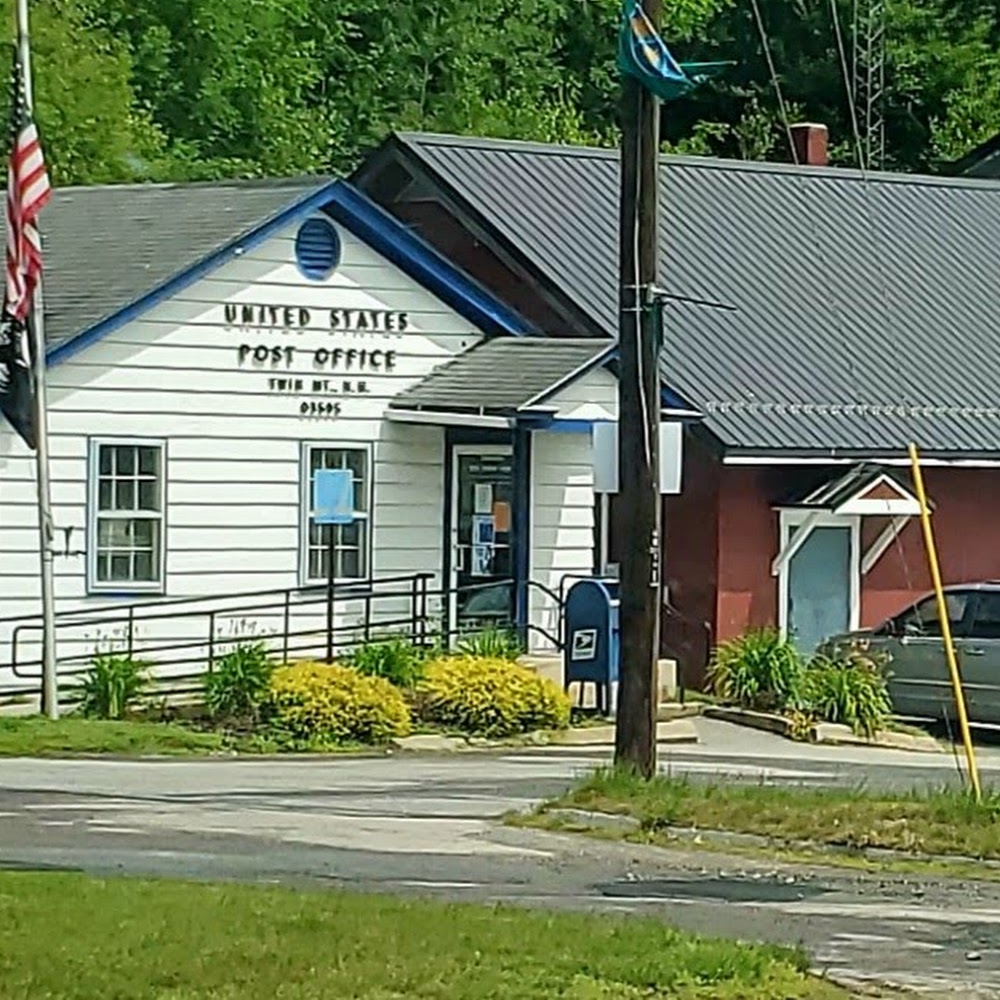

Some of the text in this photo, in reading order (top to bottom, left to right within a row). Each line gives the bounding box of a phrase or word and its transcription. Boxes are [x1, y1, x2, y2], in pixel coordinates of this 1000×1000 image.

[225, 304, 409, 330] UNITED STATES
[239, 344, 396, 368] POST OFFICE
[268, 378, 303, 391] TWIN
